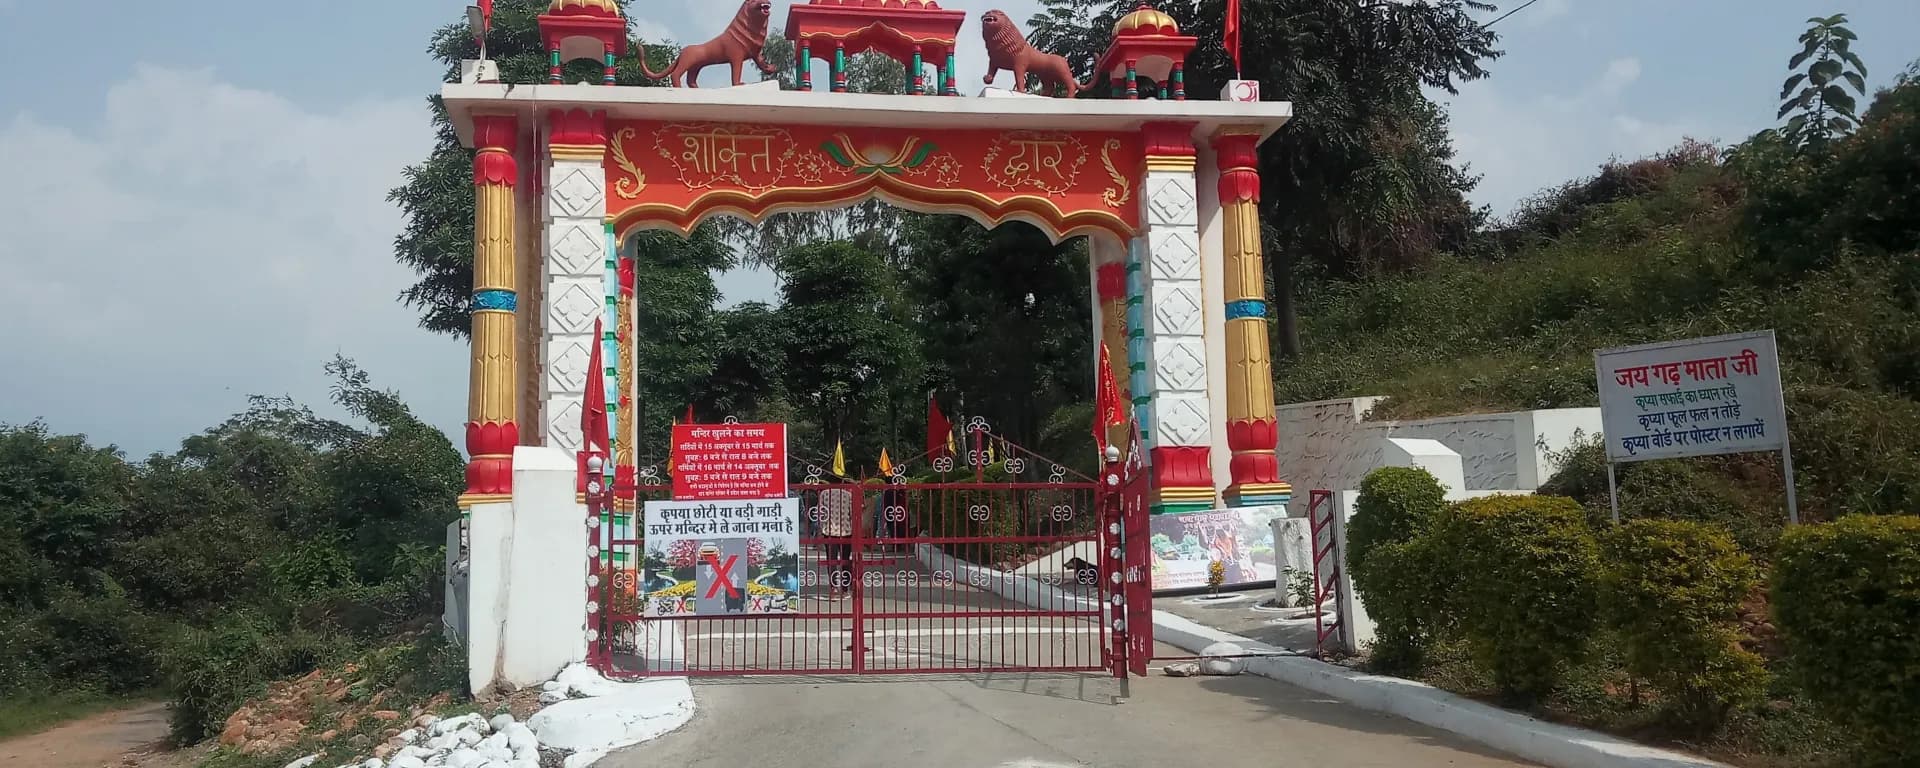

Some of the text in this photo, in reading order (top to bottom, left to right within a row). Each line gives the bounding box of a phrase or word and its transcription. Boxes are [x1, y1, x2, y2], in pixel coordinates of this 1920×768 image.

[678, 128, 1067, 179] शक्ति द्वार
[1615, 349, 1758, 388] जय गढ़ माता जी
[1659, 389, 1684, 406] सफाई
[1685, 391, 1697, 402] का
[1721, 383, 1737, 399] रखें
[1638, 412, 1665, 431] कृप्या
[1668, 410, 1687, 428] फूल
[1690, 408, 1709, 422] फल
[1711, 407, 1719, 420] न
[712, 427, 732, 440] खुलने
[747, 429, 764, 437] समय
[1622, 435, 1649, 455] कृप्या
[1674, 432, 1688, 446] पर
[1690, 425, 1721, 443] पोस्टर
[1723, 428, 1731, 440] न
[1733, 418, 1765, 438] लगायें
[660, 508, 690, 523] कृपया
[693, 504, 716, 518] छोटी
[720, 508, 732, 518] या
[757, 503, 782, 520] गाड़ी
[649, 524, 672, 535] ऊपर
[675, 519, 705, 534] मन्दिर
[720, 519, 729, 533] ले
[733, 522, 758, 533] जाना
[762, 521, 783, 532] मना
[785, 517, 793, 534] है
